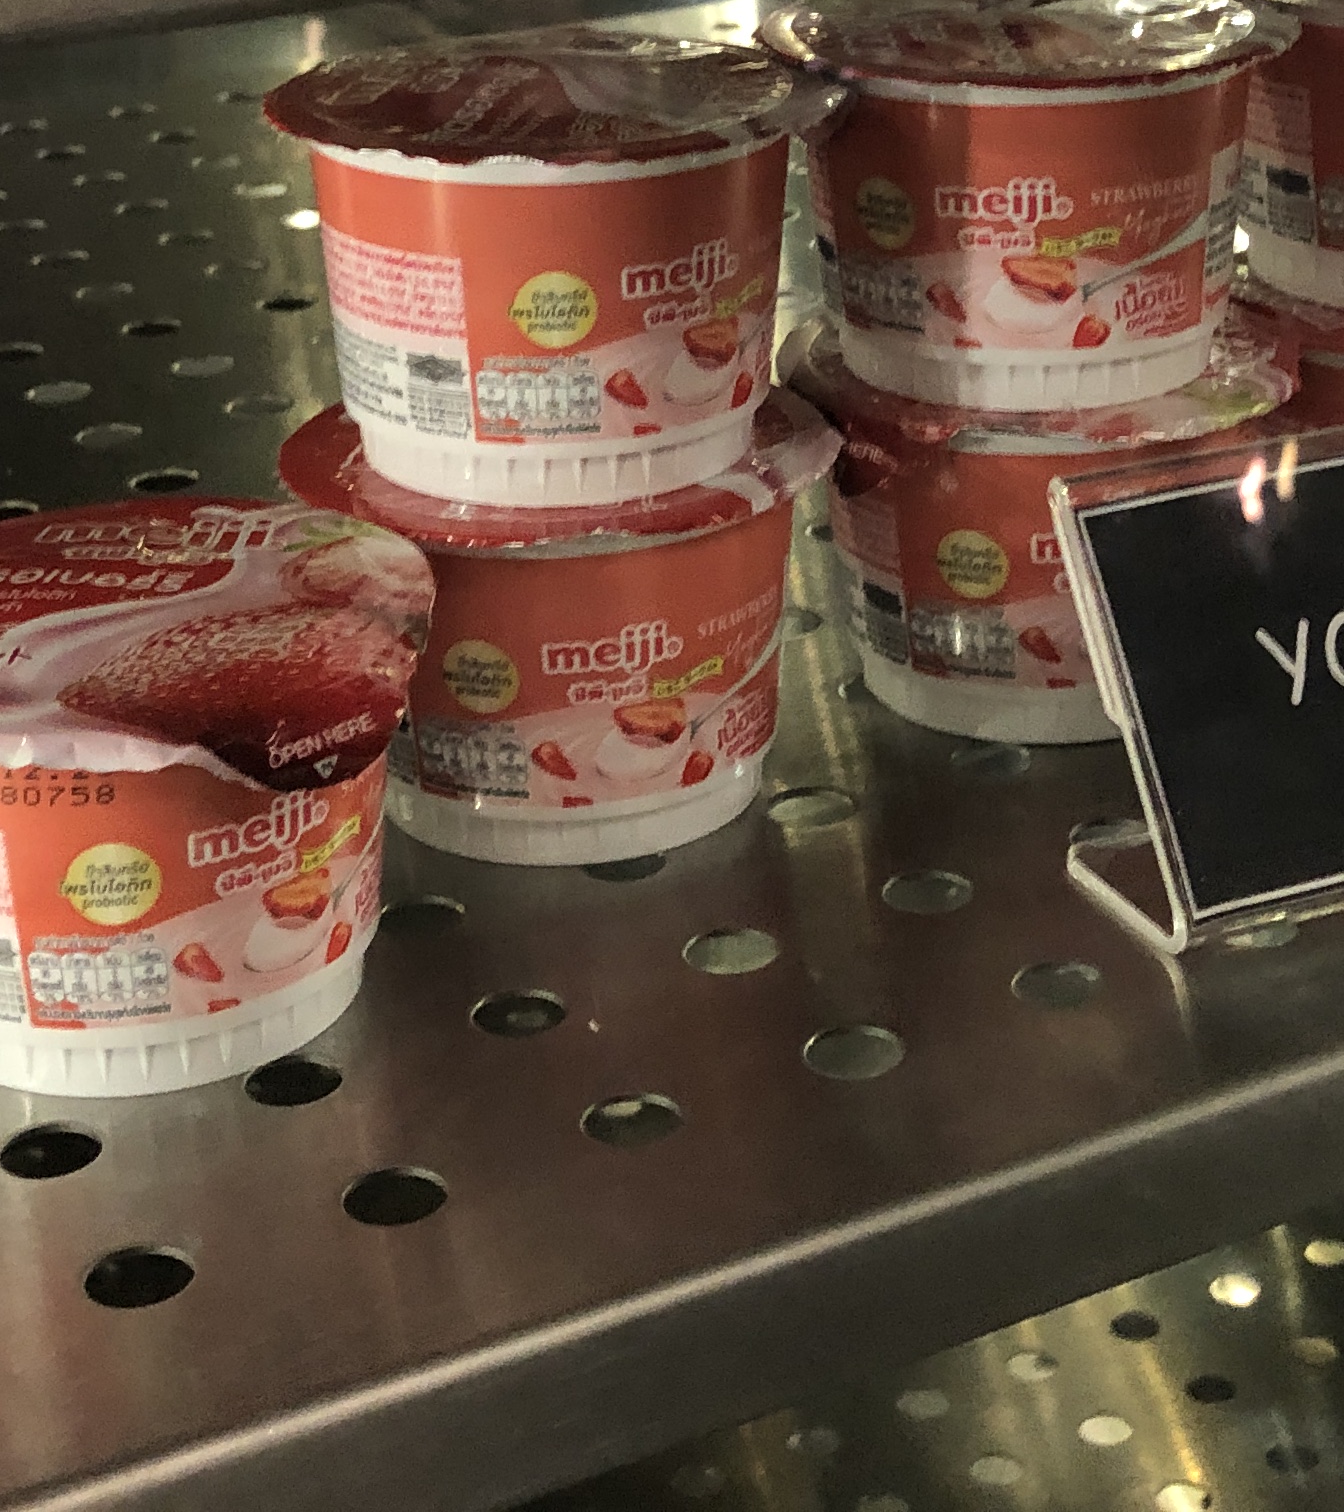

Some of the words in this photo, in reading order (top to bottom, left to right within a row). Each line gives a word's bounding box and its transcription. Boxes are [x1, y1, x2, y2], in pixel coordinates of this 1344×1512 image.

[935, 177, 1059, 222] meiji
[621, 238, 729, 301] meiji
[541, 618, 670, 678] meiji
[268, 739, 323, 770] OPEN
[322, 709, 377, 746] HERE
[187, 788, 319, 869] meiji
